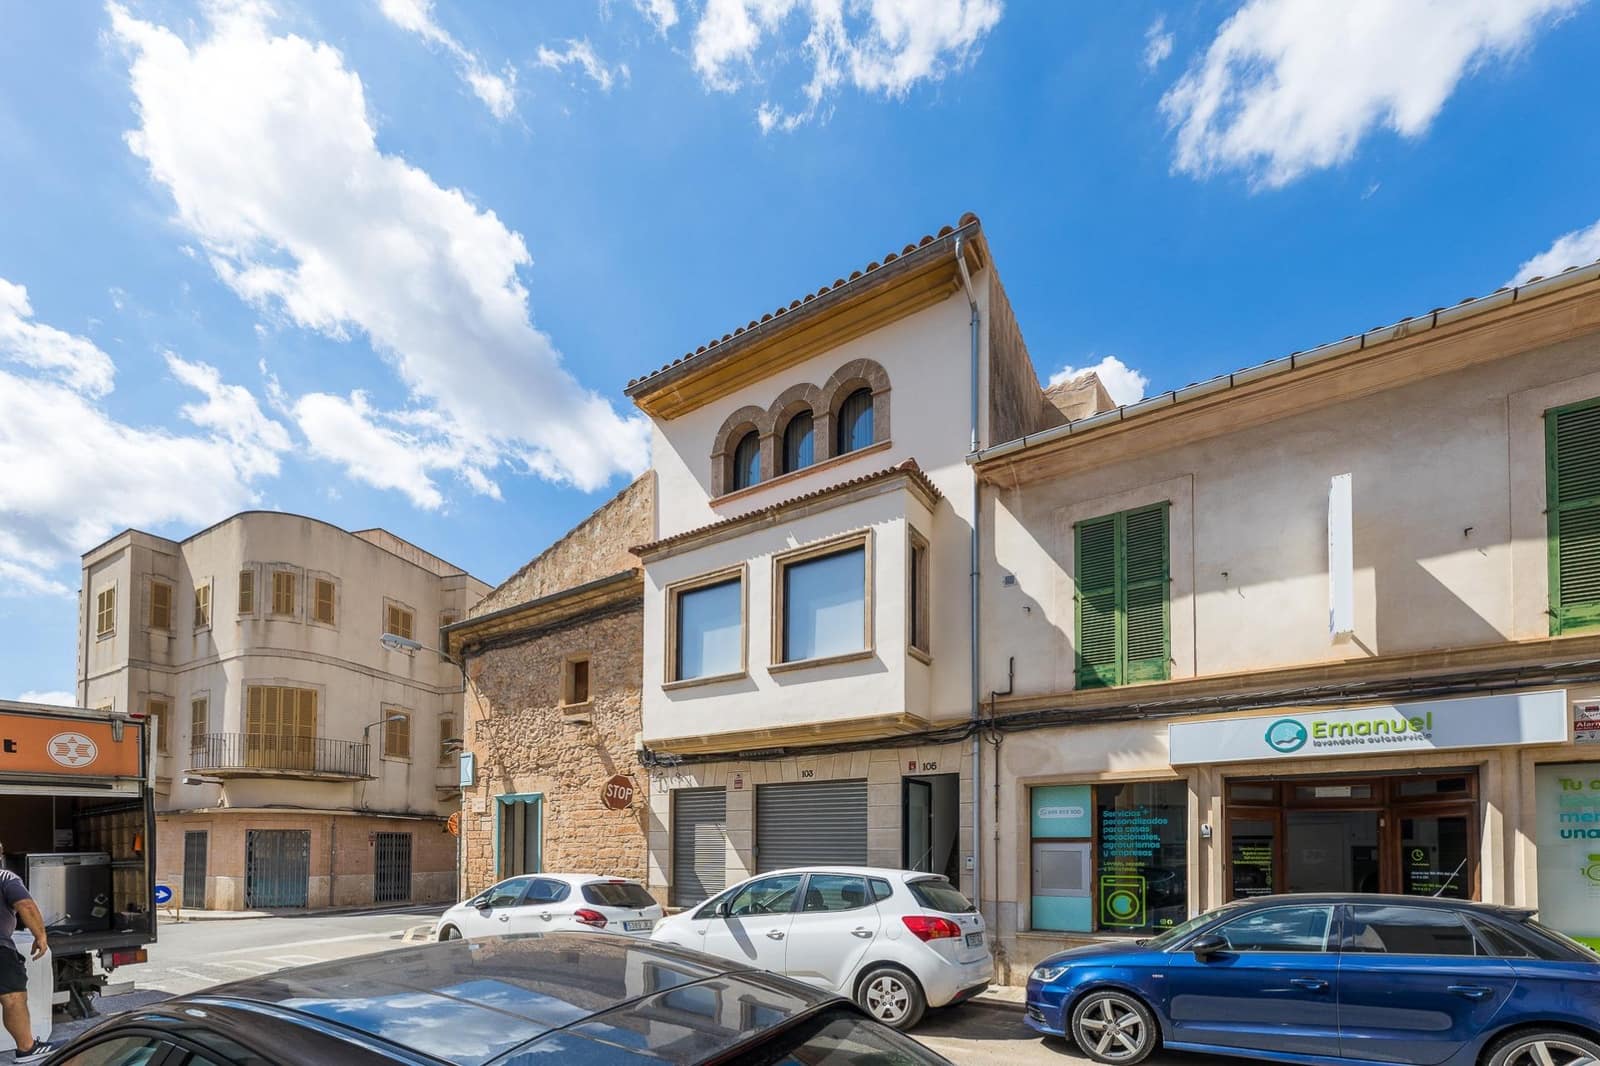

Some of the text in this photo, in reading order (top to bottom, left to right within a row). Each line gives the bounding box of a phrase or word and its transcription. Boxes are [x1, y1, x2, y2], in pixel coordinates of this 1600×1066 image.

[1312, 711, 1432, 739] Emanuel
[922, 761, 937, 771] 105
[801, 770, 814, 778] 103
[1558, 778, 1582, 791] Tu
[606, 783, 633, 801] STOP
[1103, 810, 1141, 818] Servicios
[1103, 817, 1168, 826] personalizados
[1103, 833, 1161, 841] vacacionales,
[1560, 828, 1600, 839] una
[1103, 841, 1161, 850] agroturismos
